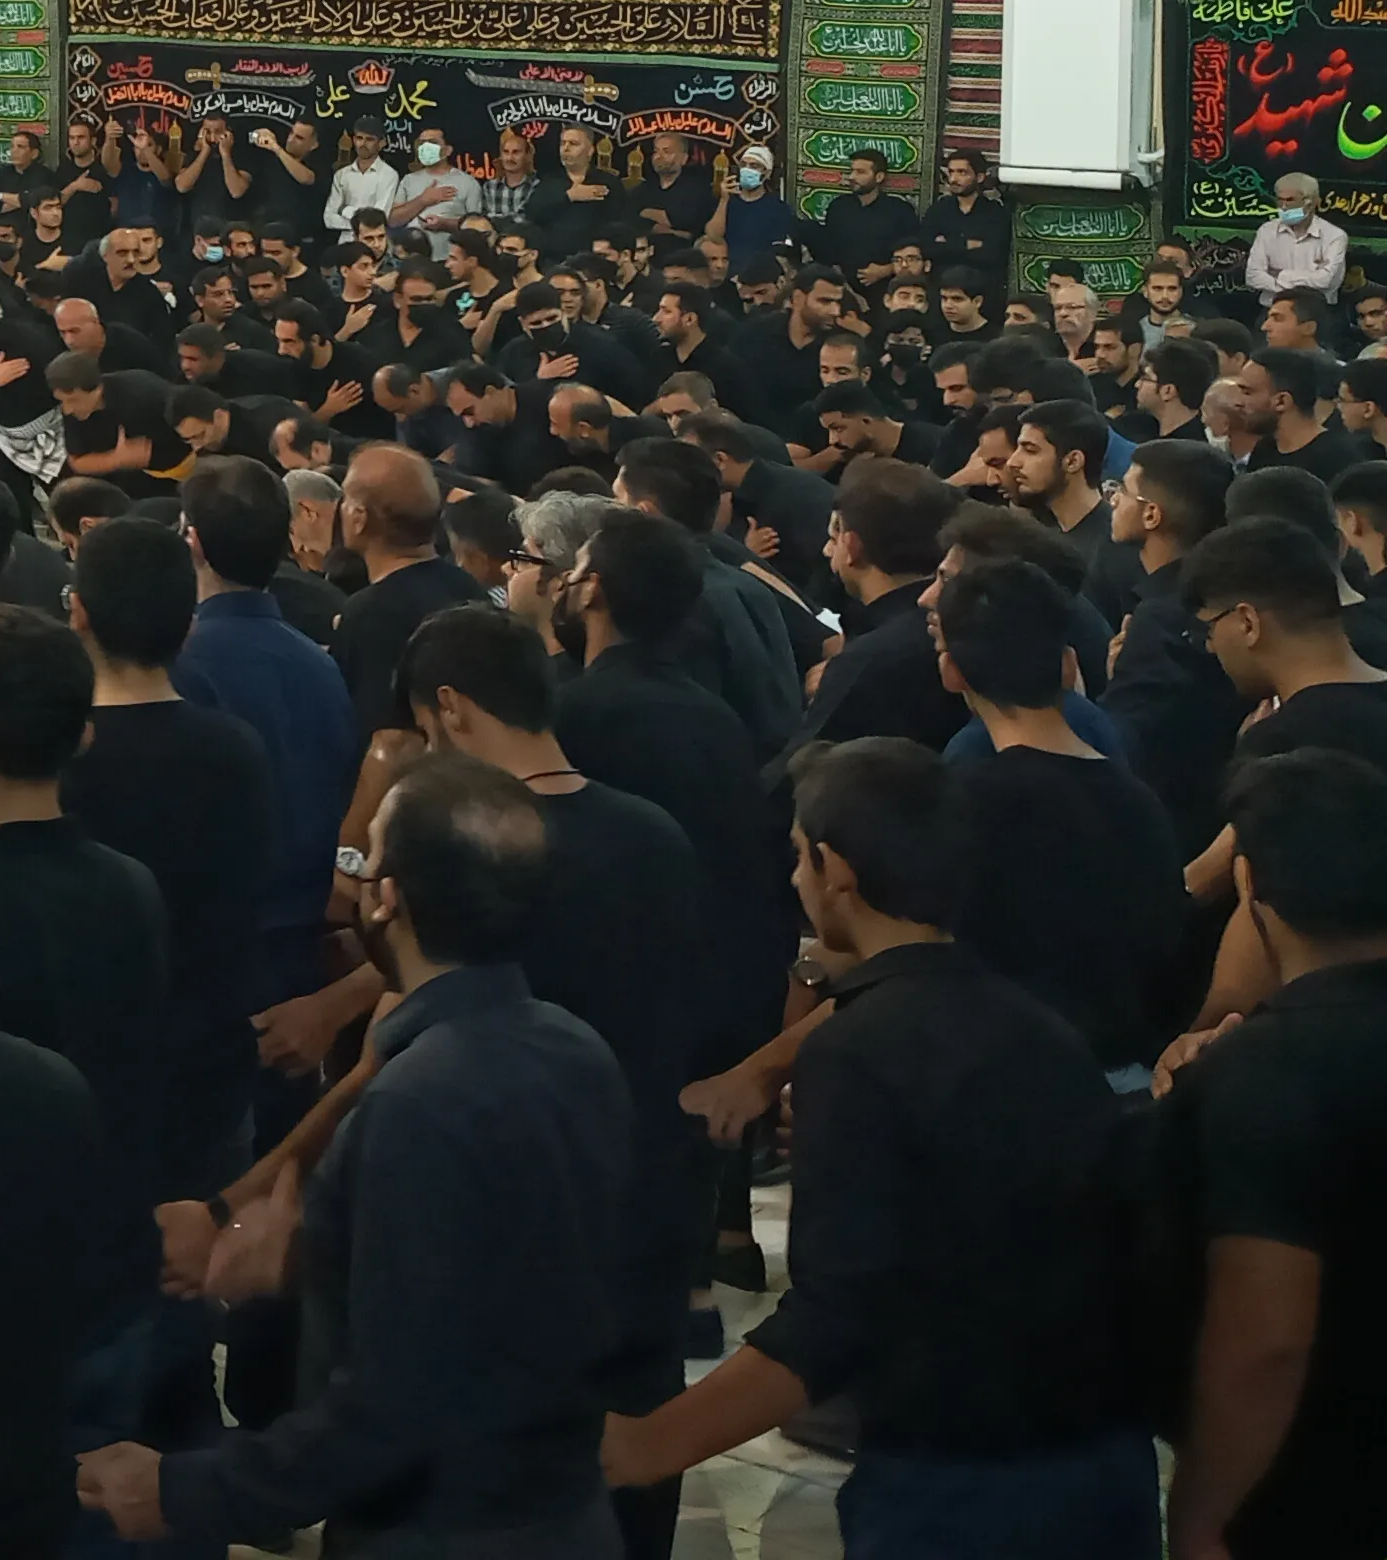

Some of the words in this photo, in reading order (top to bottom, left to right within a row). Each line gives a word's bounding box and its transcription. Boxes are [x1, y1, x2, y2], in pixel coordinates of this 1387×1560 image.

[254, 0, 320, 32] الحسین
[391, 2, 467, 37] الحسین
[555, 4, 635, 40] الحسین
[644, 5, 725, 42] السلام
[316, 75, 350, 118] علی
[385, 81, 437, 120] محمد
[674, 75, 735, 106] حسن
